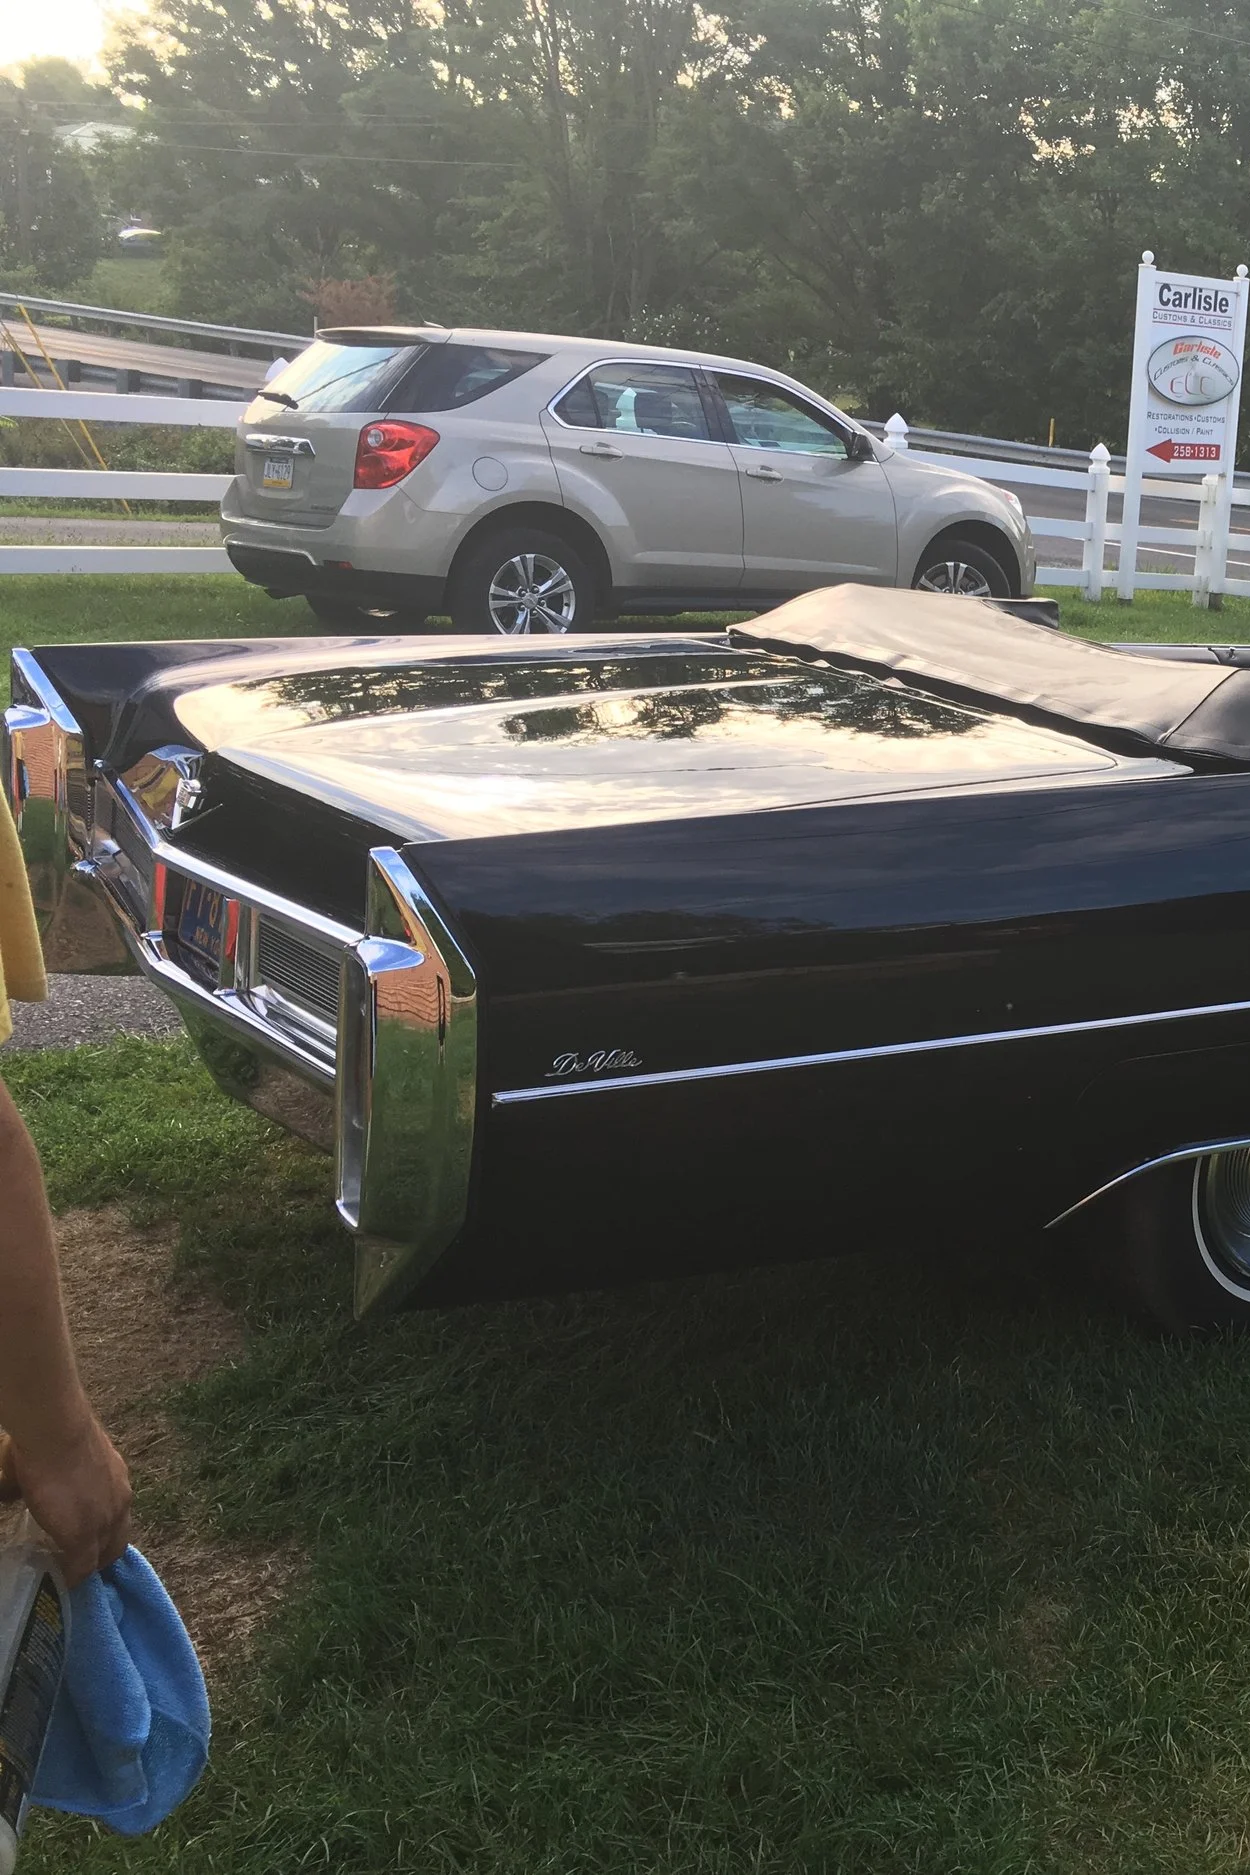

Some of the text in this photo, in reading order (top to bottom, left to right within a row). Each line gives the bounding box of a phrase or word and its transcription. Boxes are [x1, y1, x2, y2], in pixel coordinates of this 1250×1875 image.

[1159, 283, 1229, 313] Carlisle
[1152, 311, 1188, 323] CUSTOMS
[1198, 316, 1232, 328] CLASSICS
[1190, 354, 1199, 362] &
[1196, 427, 1213, 436] PAINT
